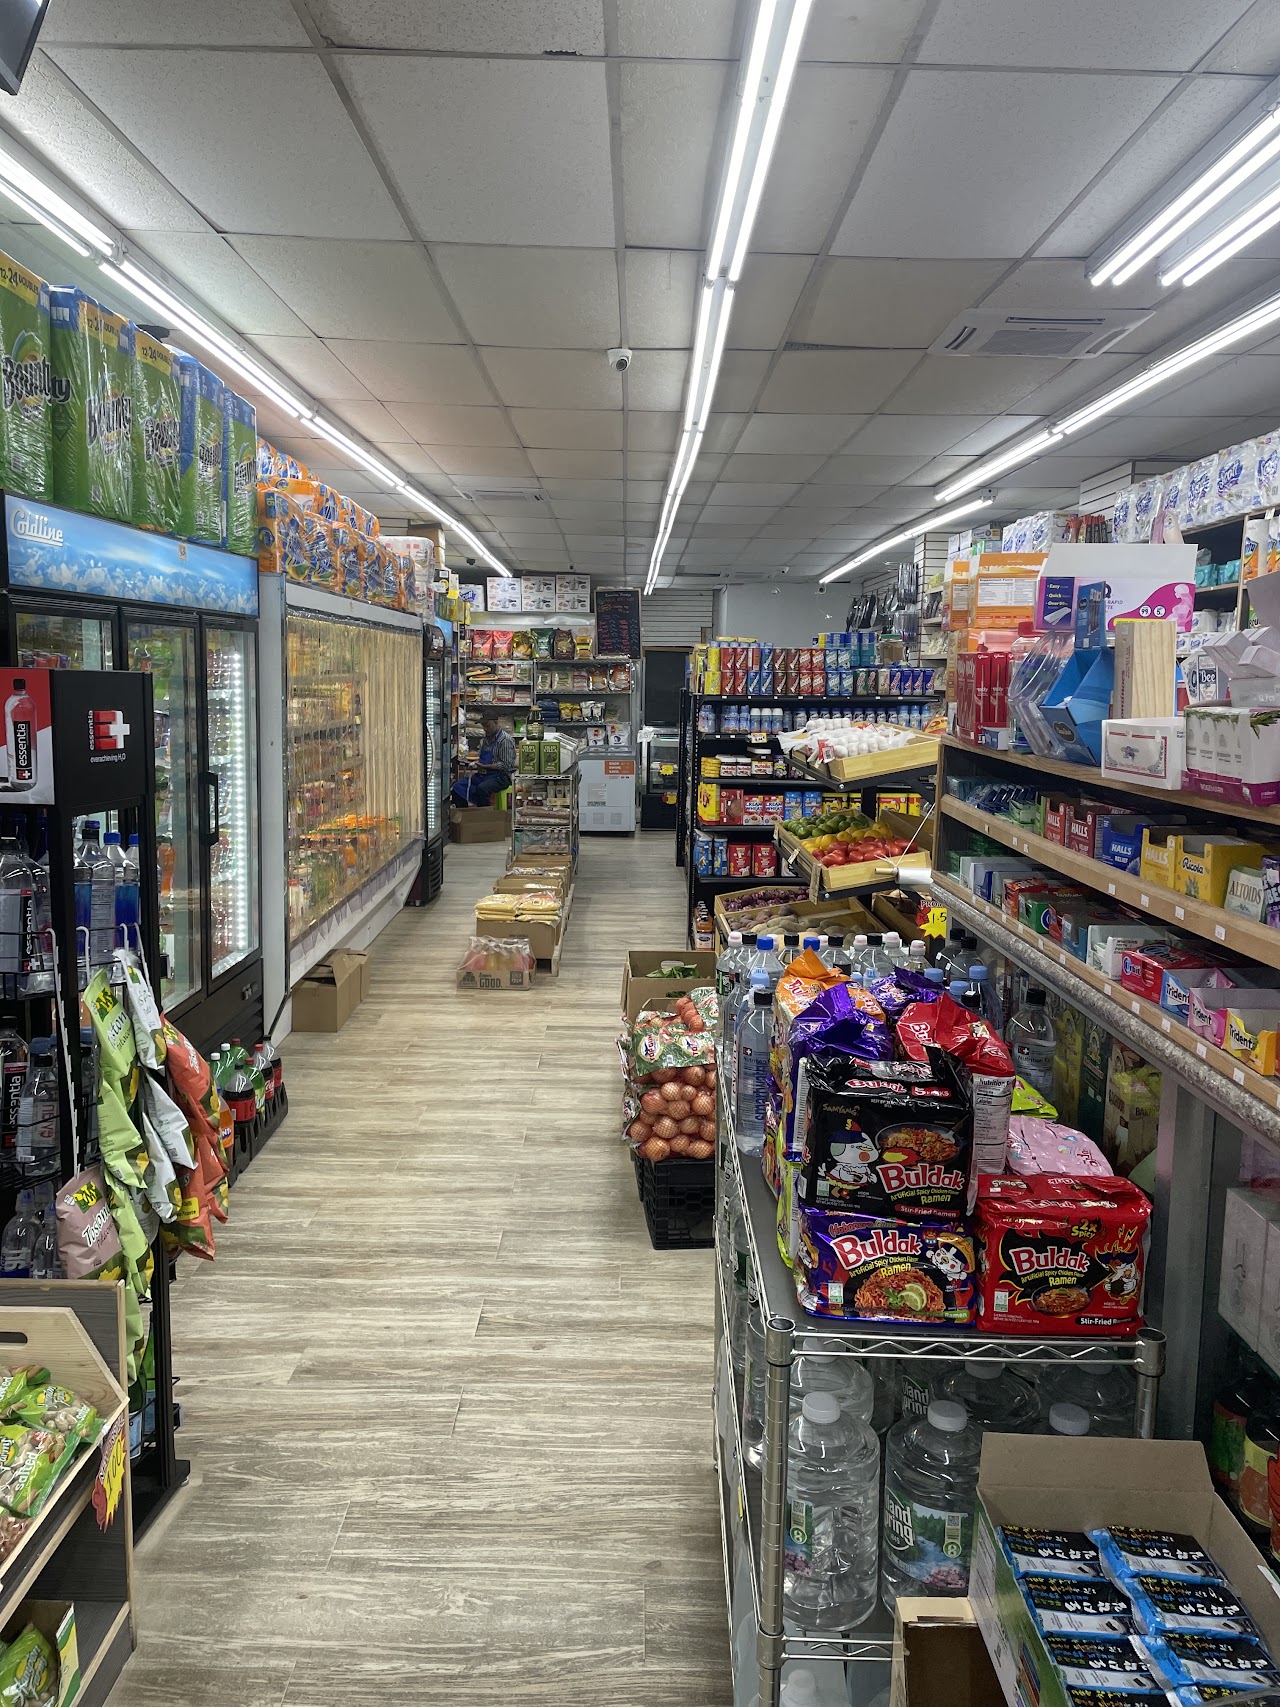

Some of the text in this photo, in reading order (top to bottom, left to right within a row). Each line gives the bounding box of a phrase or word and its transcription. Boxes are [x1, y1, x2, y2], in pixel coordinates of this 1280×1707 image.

[19, 274, 39, 296] DOUBLES
[10, 508, 64, 543] Coldline
[1201, 671, 1216, 683] Bee
[16, 723, 28, 766] essentia
[1048, 815, 1060, 828] HALLS
[1071, 823, 1088, 838] HALLS
[1111, 844, 1132, 855] HALLS
[1146, 847, 1169, 866] HALLS
[1115, 856, 1129, 864] RELIEF
[1183, 857, 1205, 875] Ricola
[1229, 880, 1262, 905] ALTOIDS
[1123, 956, 1142, 977] Orbit
[1192, 1003, 1213, 1026] Trident
[1229, 1024, 1254, 1049] Trident
[822, 1104, 860, 1117] SAMYANG
[876, 1163, 965, 1194] Buldak
[890, 1190, 916, 1201] Artificial
[921, 1194, 951, 1205] Ramen
[900, 1205, 932, 1215] Stir-Fried
[1071, 1226, 1096, 1240] Spicy
[831, 1230, 922, 1270] Buldak
[849, 1261, 874, 1279] Artificial
[874, 1259, 889, 1268] Spicy
[1009, 1246, 1090, 1276] Buldak
[880, 1262, 911, 1279] Ramen
[1021, 1271, 1045, 1284] Artificial
[1045, 1270, 1058, 1278] Spicy
[1049, 1277, 1077, 1287] Ramen
[1080, 1317, 1112, 1326] Stir-Fried
[15, 1450, 39, 1492] salted
